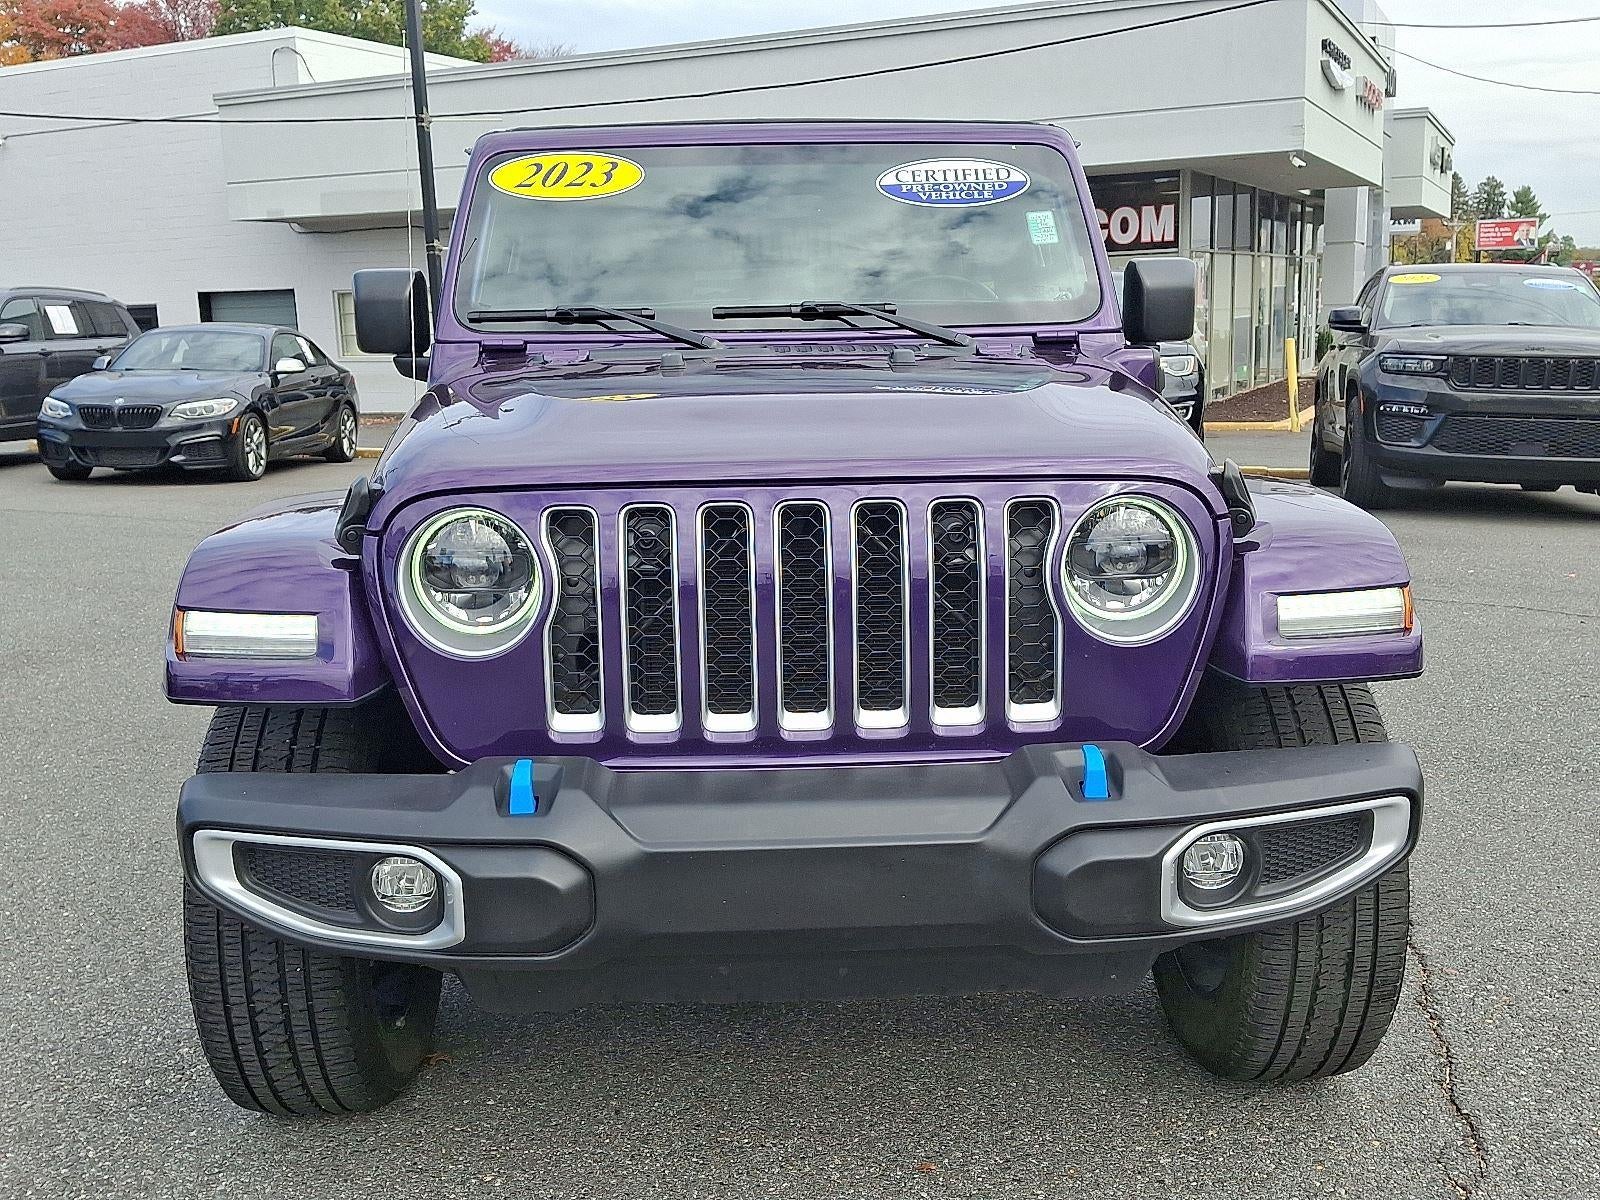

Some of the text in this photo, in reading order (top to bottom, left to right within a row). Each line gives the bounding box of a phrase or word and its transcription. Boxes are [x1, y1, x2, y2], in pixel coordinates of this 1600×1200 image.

[514, 161, 618, 188] 2023
[895, 167, 1011, 183] CERTIFIED
[900, 181, 1008, 193] PRE-OWNED
[917, 190, 994, 201] VEHICLE
